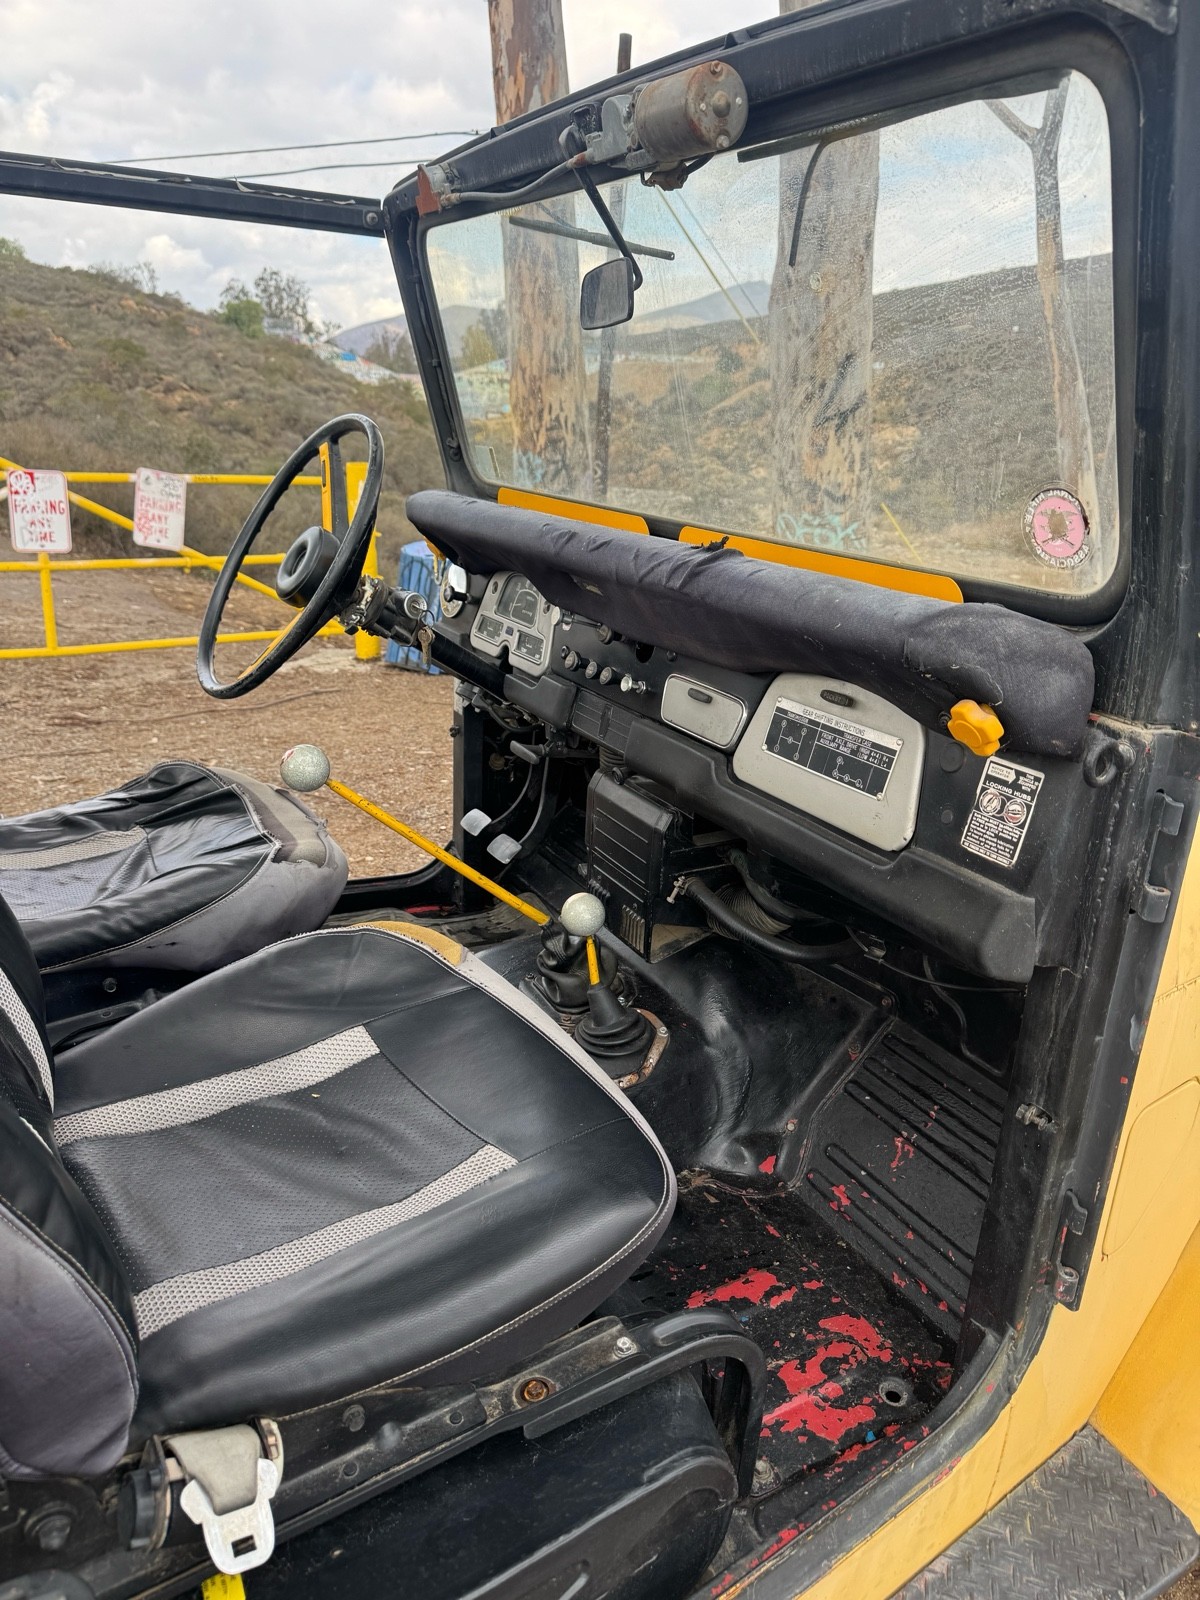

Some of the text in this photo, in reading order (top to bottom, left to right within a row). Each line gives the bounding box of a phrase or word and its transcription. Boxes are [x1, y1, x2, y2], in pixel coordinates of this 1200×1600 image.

[14, 499, 65, 515] PARING
[803, 709, 866, 736] GEAR SHIFTING INSTRUCTIONS
[821, 733, 834, 742] FRONT
[846, 742, 858, 750] DRIVE
[843, 733, 862, 744] TRANSFER
[839, 745, 852, 754] RANGE
[986, 781, 1032, 802] LOCKING HUBS
